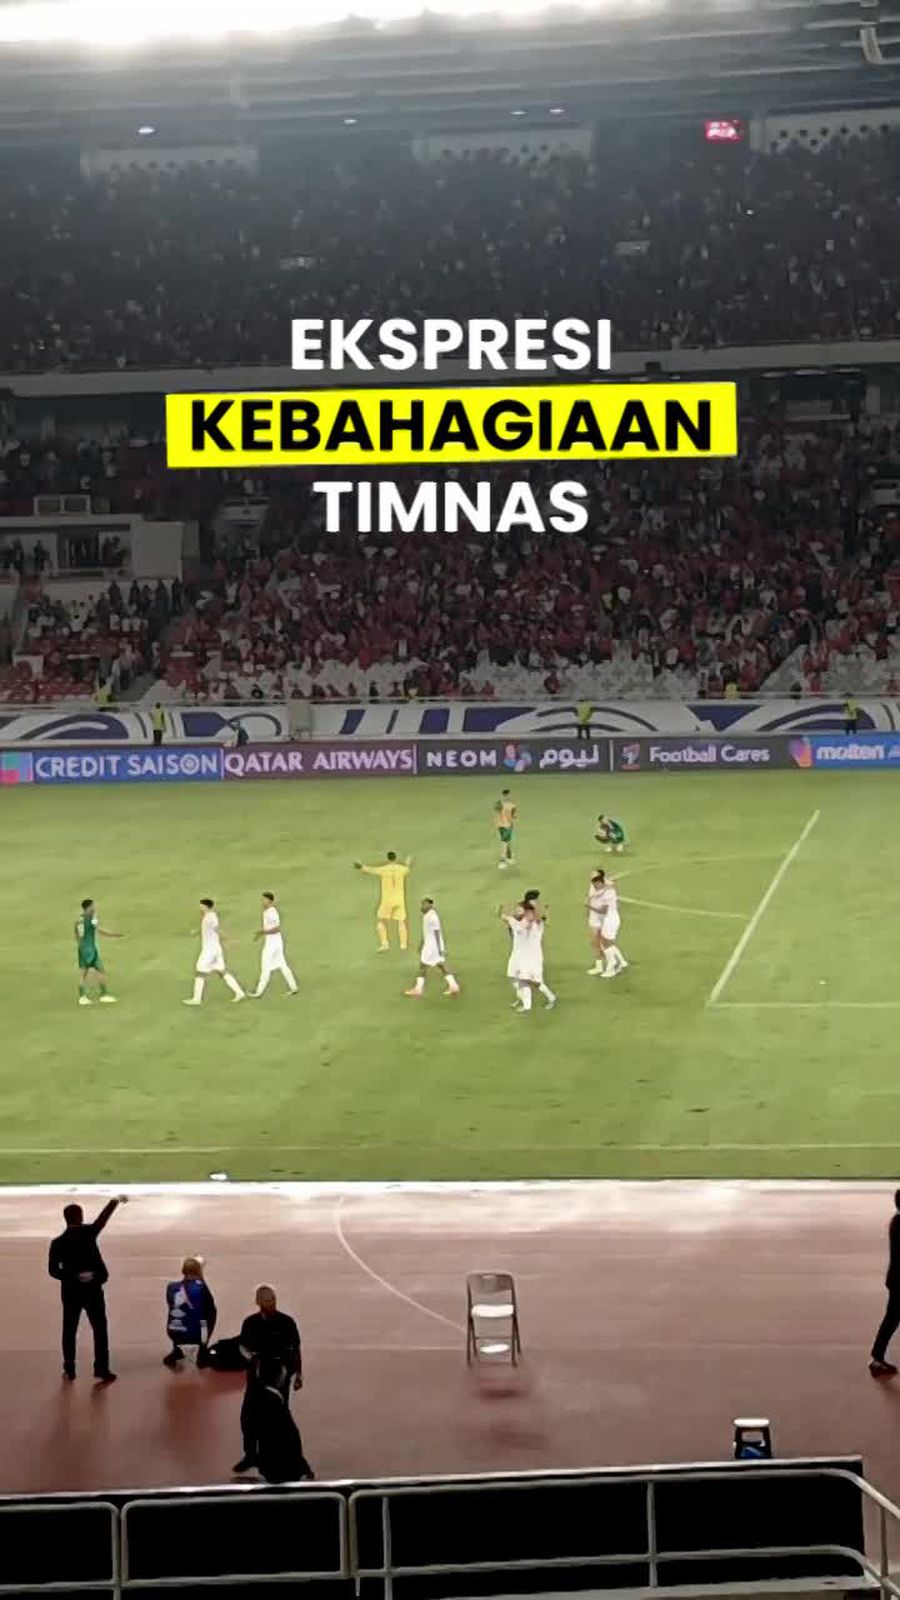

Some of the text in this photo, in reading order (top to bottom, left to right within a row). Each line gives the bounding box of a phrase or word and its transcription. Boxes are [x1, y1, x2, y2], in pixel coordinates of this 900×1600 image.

[426, 750, 497, 768] NEOM
[649, 744, 770, 762] Football Cares
[816, 743, 885, 760] molten
[35, 754, 218, 778] CREDIT SAISON
[224, 749, 413, 776] QATAR AIRWAYS
